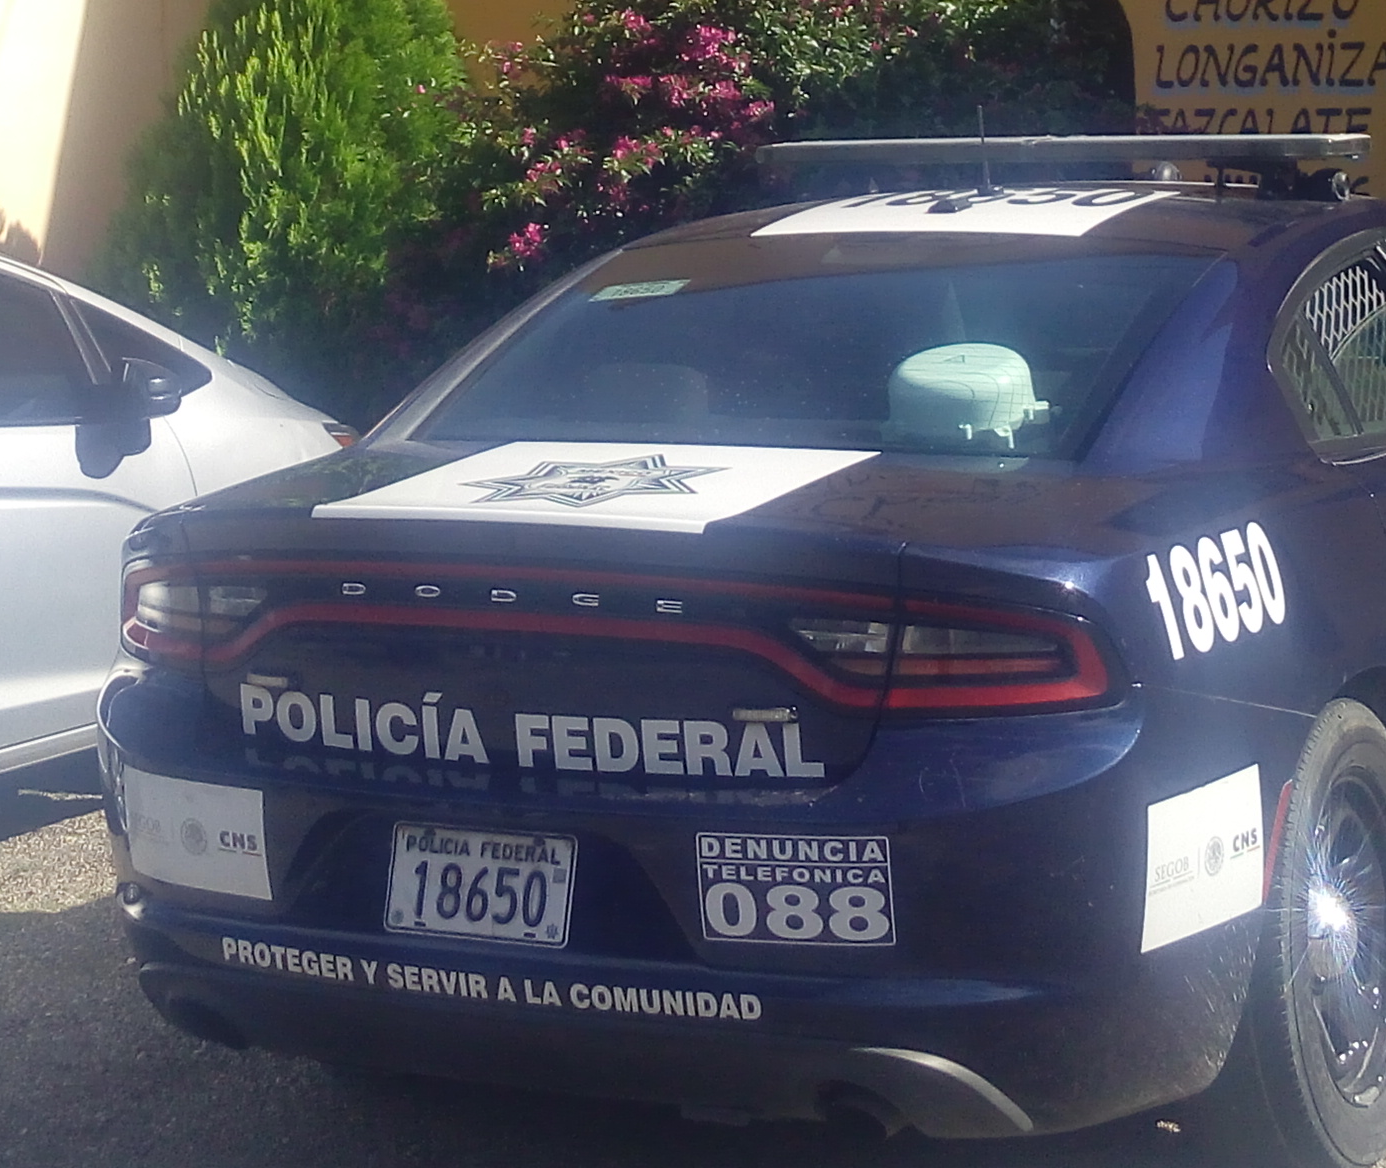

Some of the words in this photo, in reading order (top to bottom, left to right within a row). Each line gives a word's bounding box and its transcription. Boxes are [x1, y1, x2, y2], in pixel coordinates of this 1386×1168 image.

[341, 582, 683, 614] DODGE
[1145, 521, 1287, 661] 18650
[240, 683, 489, 763] POLICÍA
[514, 713, 825, 778] FEDERAL
[219, 830, 258, 852] CNS
[480, 841, 562, 866] FEDERAL
[700, 836, 885, 862] DENUNCIA
[1154, 856, 1190, 883] SEGOB
[1232, 827, 1258, 853] CNS
[414, 859, 548, 928] 18650
[702, 863, 886, 884] TELEFONICA
[705, 881, 891, 942] 088
[221, 936, 355, 982] PROTEGER
[360, 958, 377, 985] Y
[387, 963, 489, 999] SERVIR
[497, 975, 517, 1002] A
[524, 978, 562, 1008] LA
[569, 982, 763, 1020] COMUNIDAD
